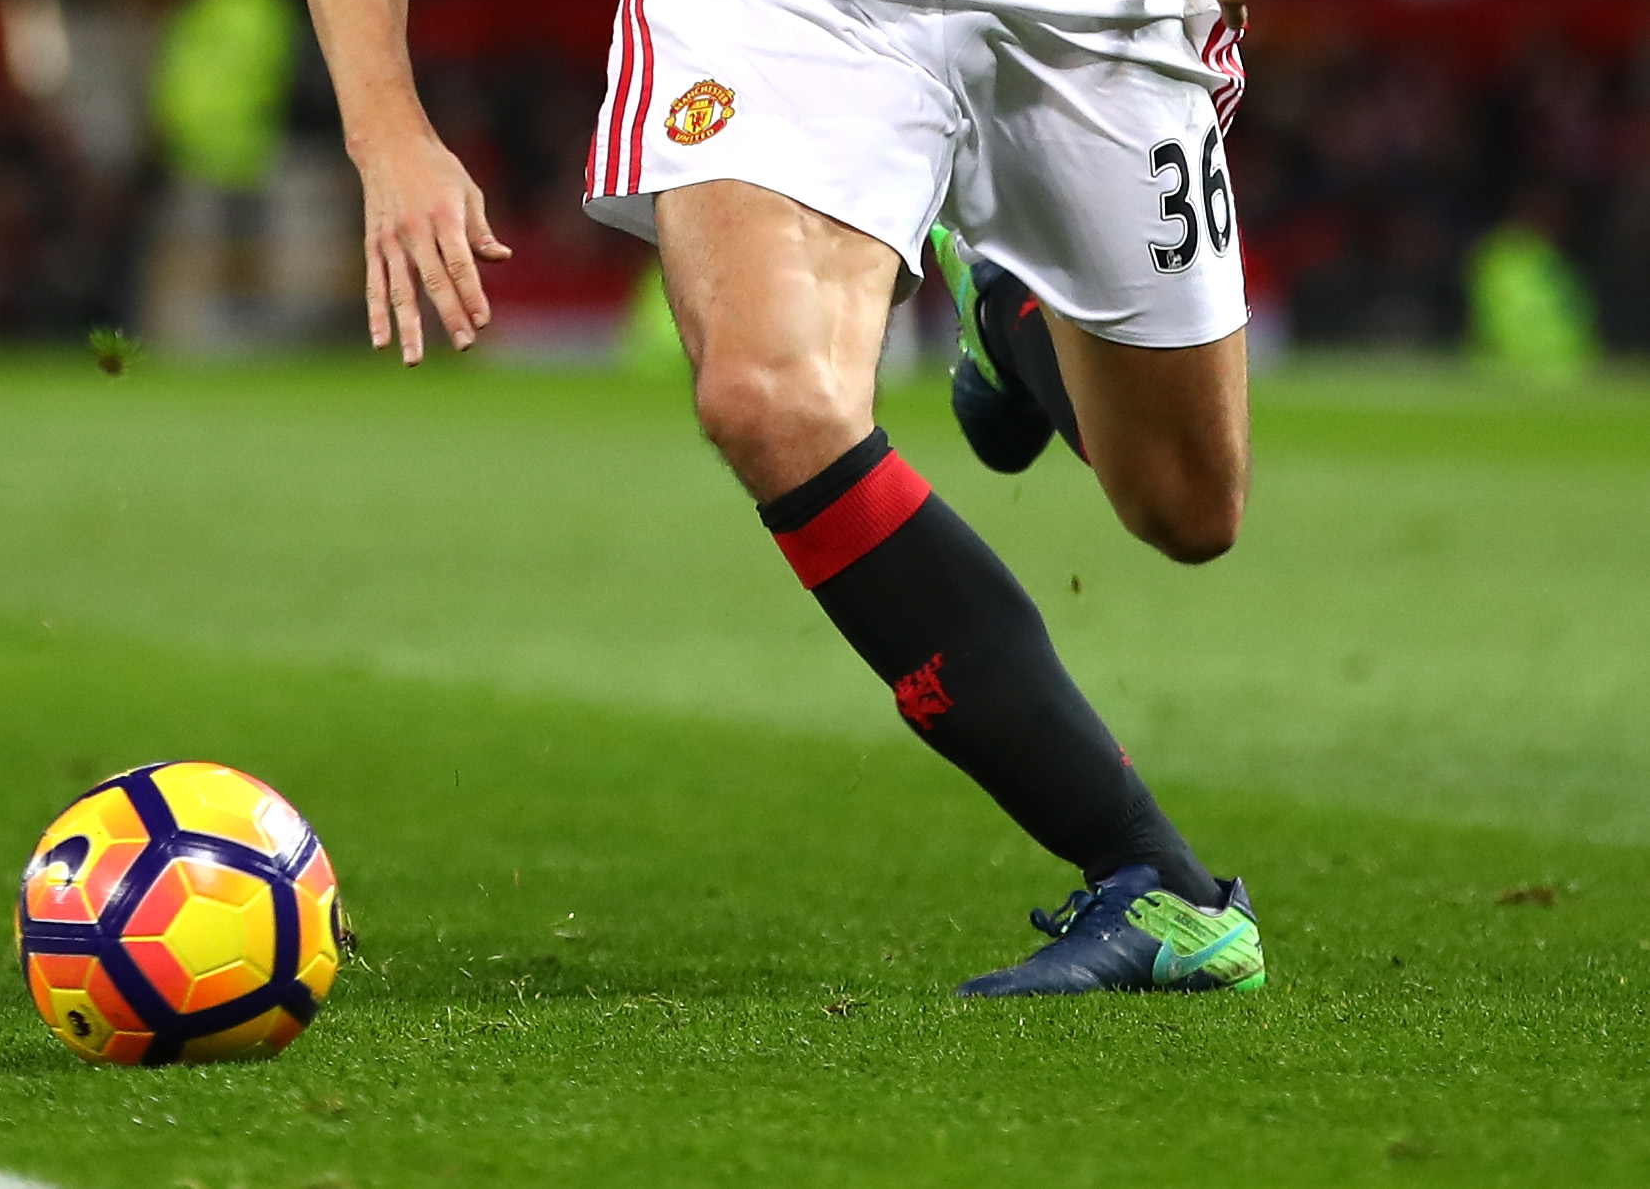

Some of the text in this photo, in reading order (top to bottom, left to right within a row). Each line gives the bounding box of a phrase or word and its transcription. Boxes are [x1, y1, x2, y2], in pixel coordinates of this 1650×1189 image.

[673, 84, 730, 112] MANCHESTER
[674, 127, 715, 144] UNITED
[1148, 120, 1232, 274] 36
